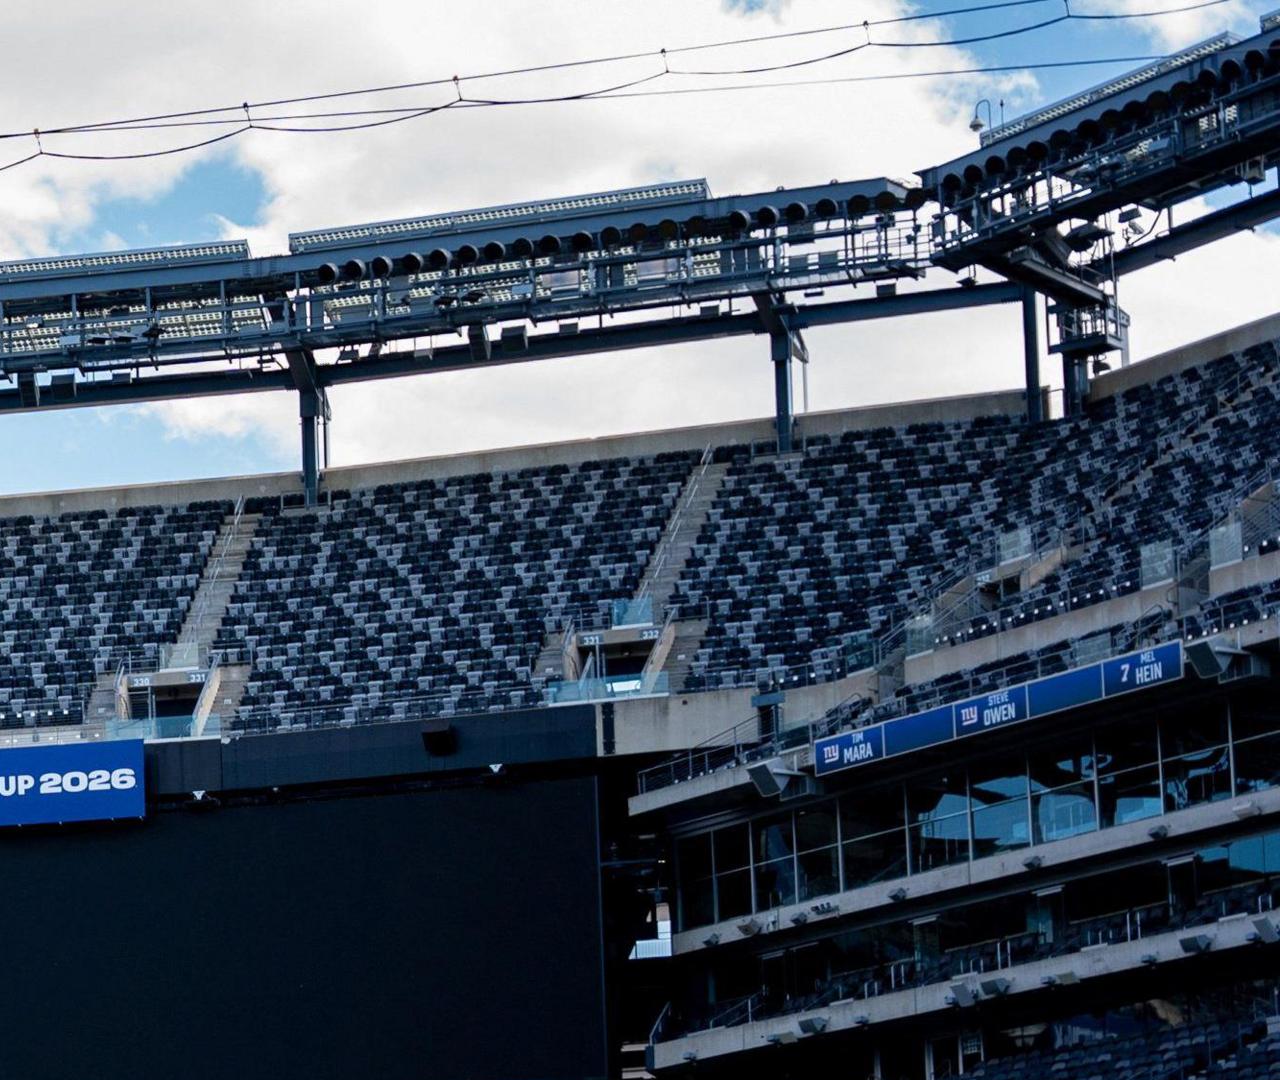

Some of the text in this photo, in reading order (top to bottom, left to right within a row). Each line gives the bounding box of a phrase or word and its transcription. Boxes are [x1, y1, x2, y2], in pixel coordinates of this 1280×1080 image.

[1140, 651, 1156, 664] MEL
[1120, 661, 1162, 685] 7 HEIN
[988, 691, 1009, 706] STEVE
[983, 702, 1016, 727] OWEN
[851, 731, 864, 744] TIM
[843, 742, 874, 764] MARA
[39, 768, 136, 794] 2026
